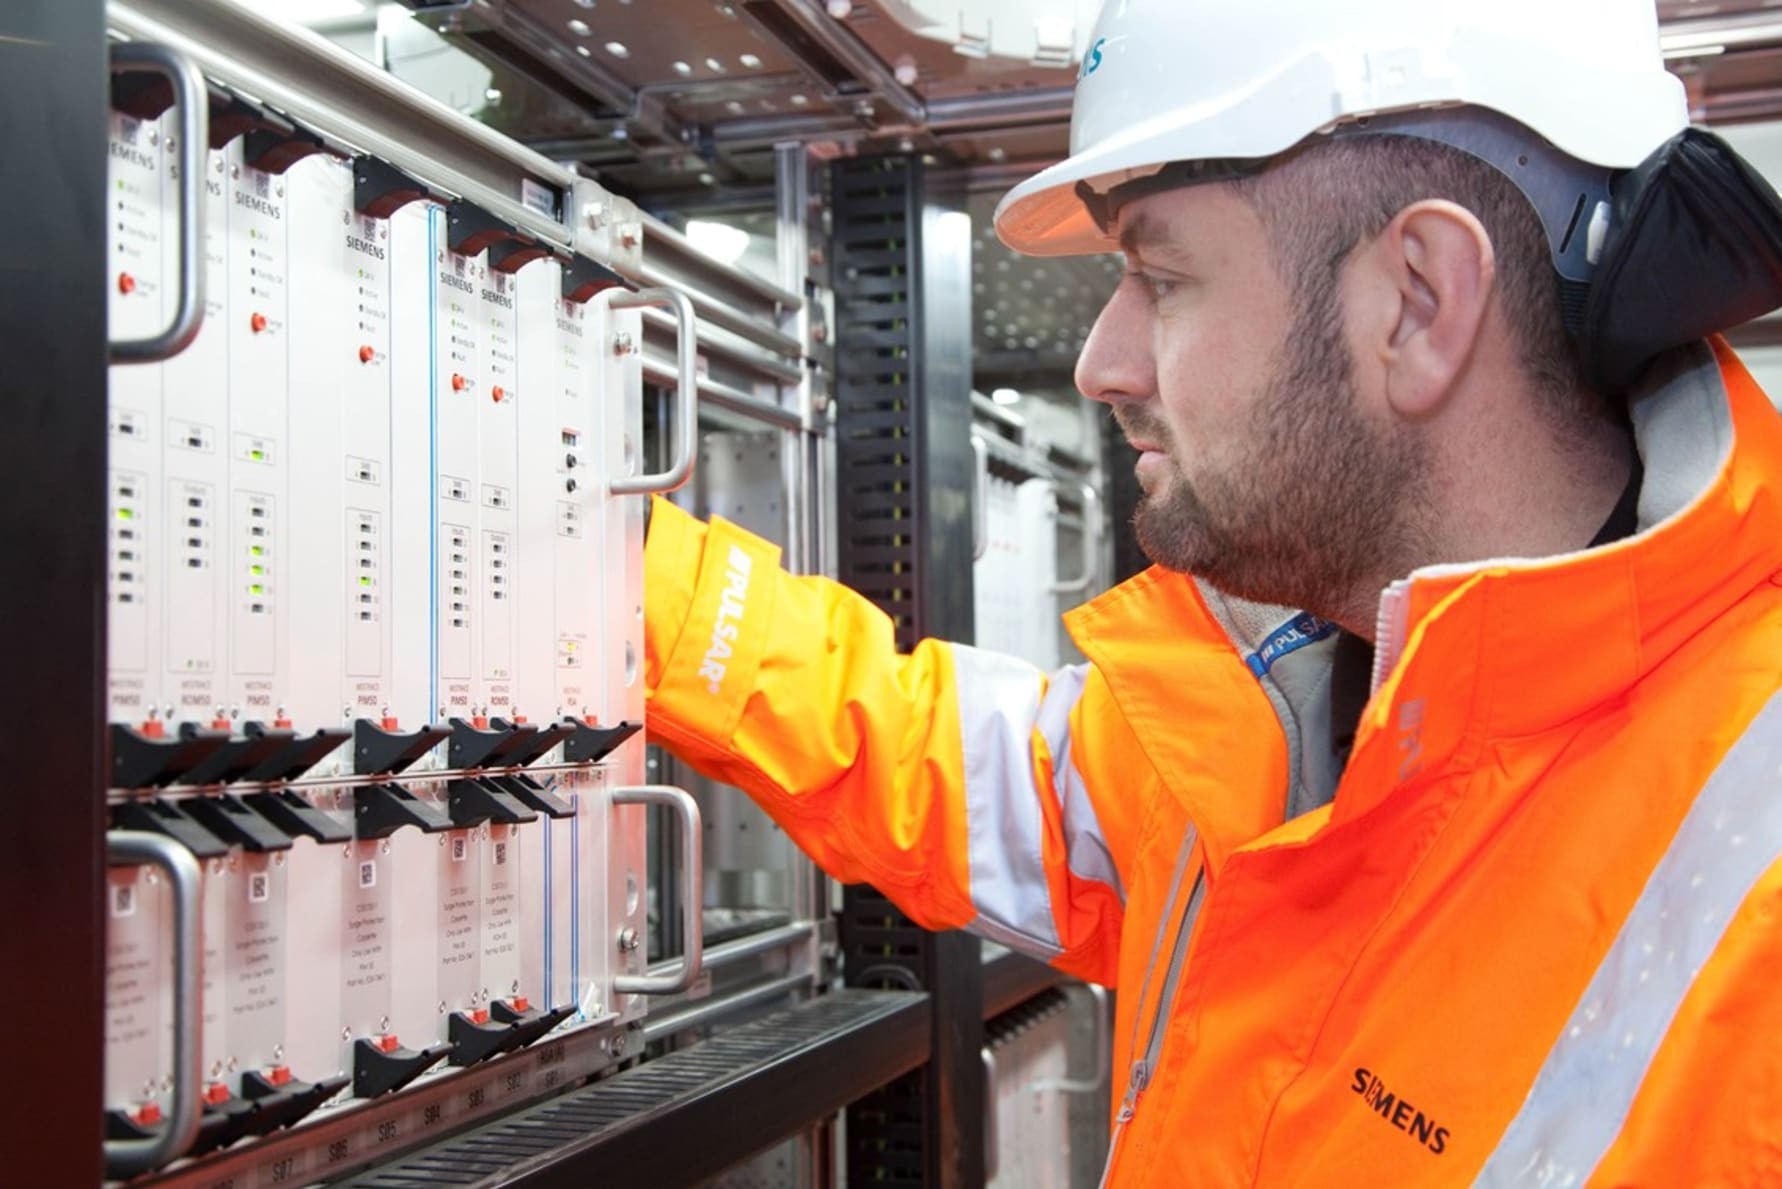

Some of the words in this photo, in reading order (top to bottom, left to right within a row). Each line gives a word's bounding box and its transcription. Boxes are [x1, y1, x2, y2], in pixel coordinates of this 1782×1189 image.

[235, 191, 281, 220] SIEMENS
[346, 235, 386, 261] SIEMENS
[440, 271, 474, 295] SIEMENS
[481, 288, 513, 310] SIEMENS
[697, 566, 750, 684] PULSAR
[423, 1104, 441, 1126] S04
[378, 1119, 396, 1142] S05
